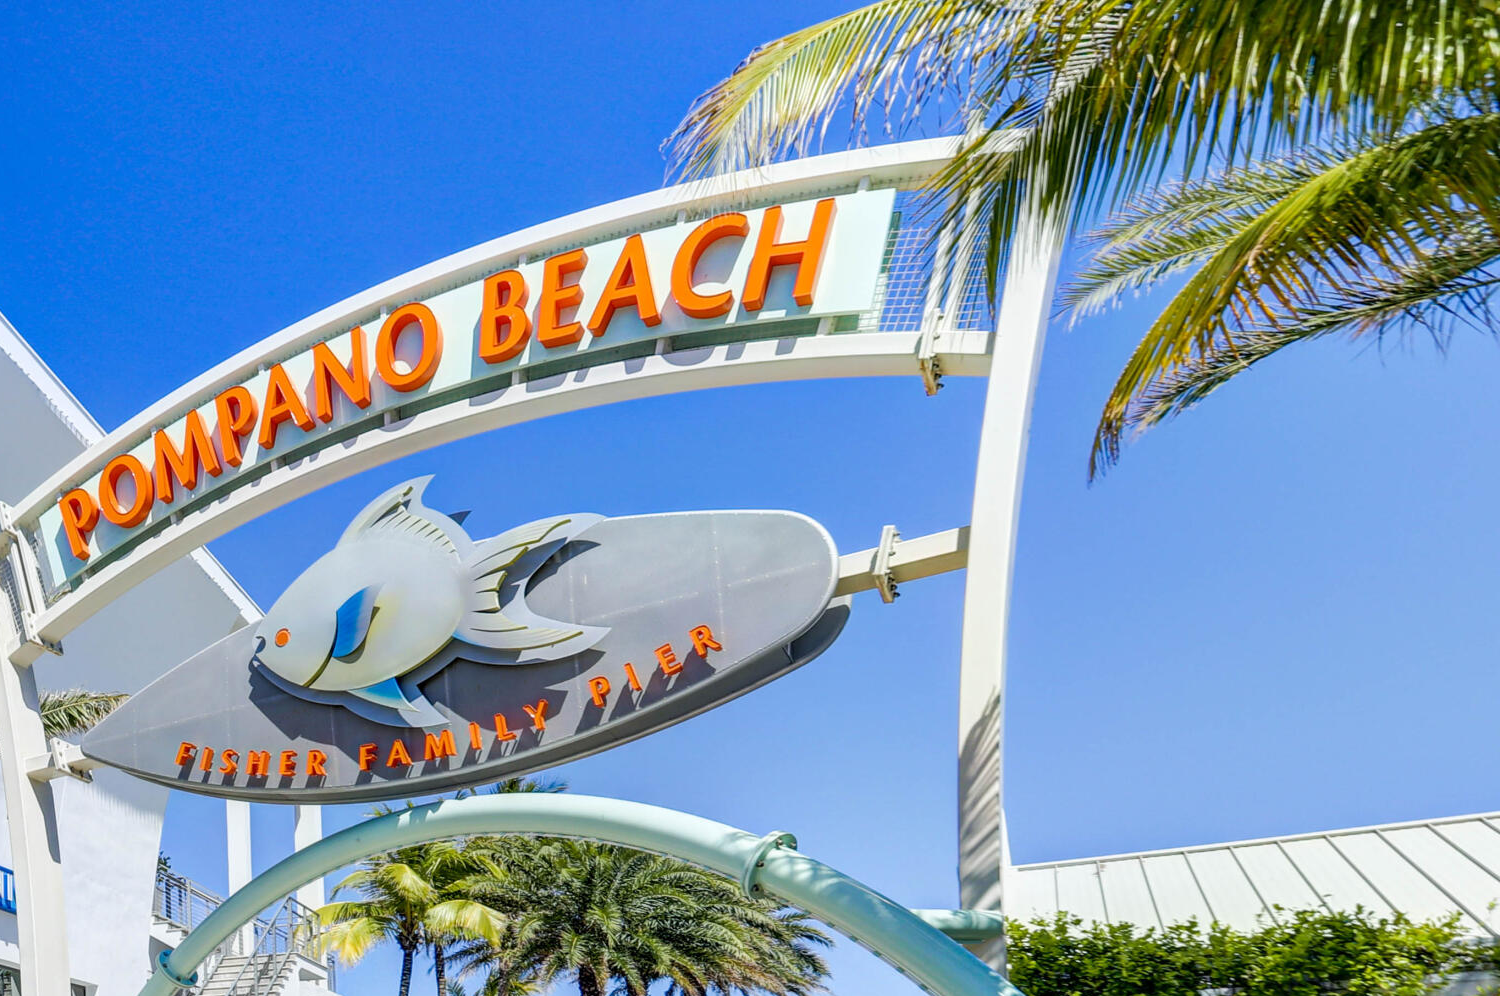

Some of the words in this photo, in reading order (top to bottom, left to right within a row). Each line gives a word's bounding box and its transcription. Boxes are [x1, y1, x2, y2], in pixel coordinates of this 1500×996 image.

[59, 302, 443, 561] POMPANO
[479, 198, 838, 364] BEACH
[175, 741, 329, 777] FISHER
[358, 699, 548, 772] FAMILY
[588, 625, 723, 708] PIER
